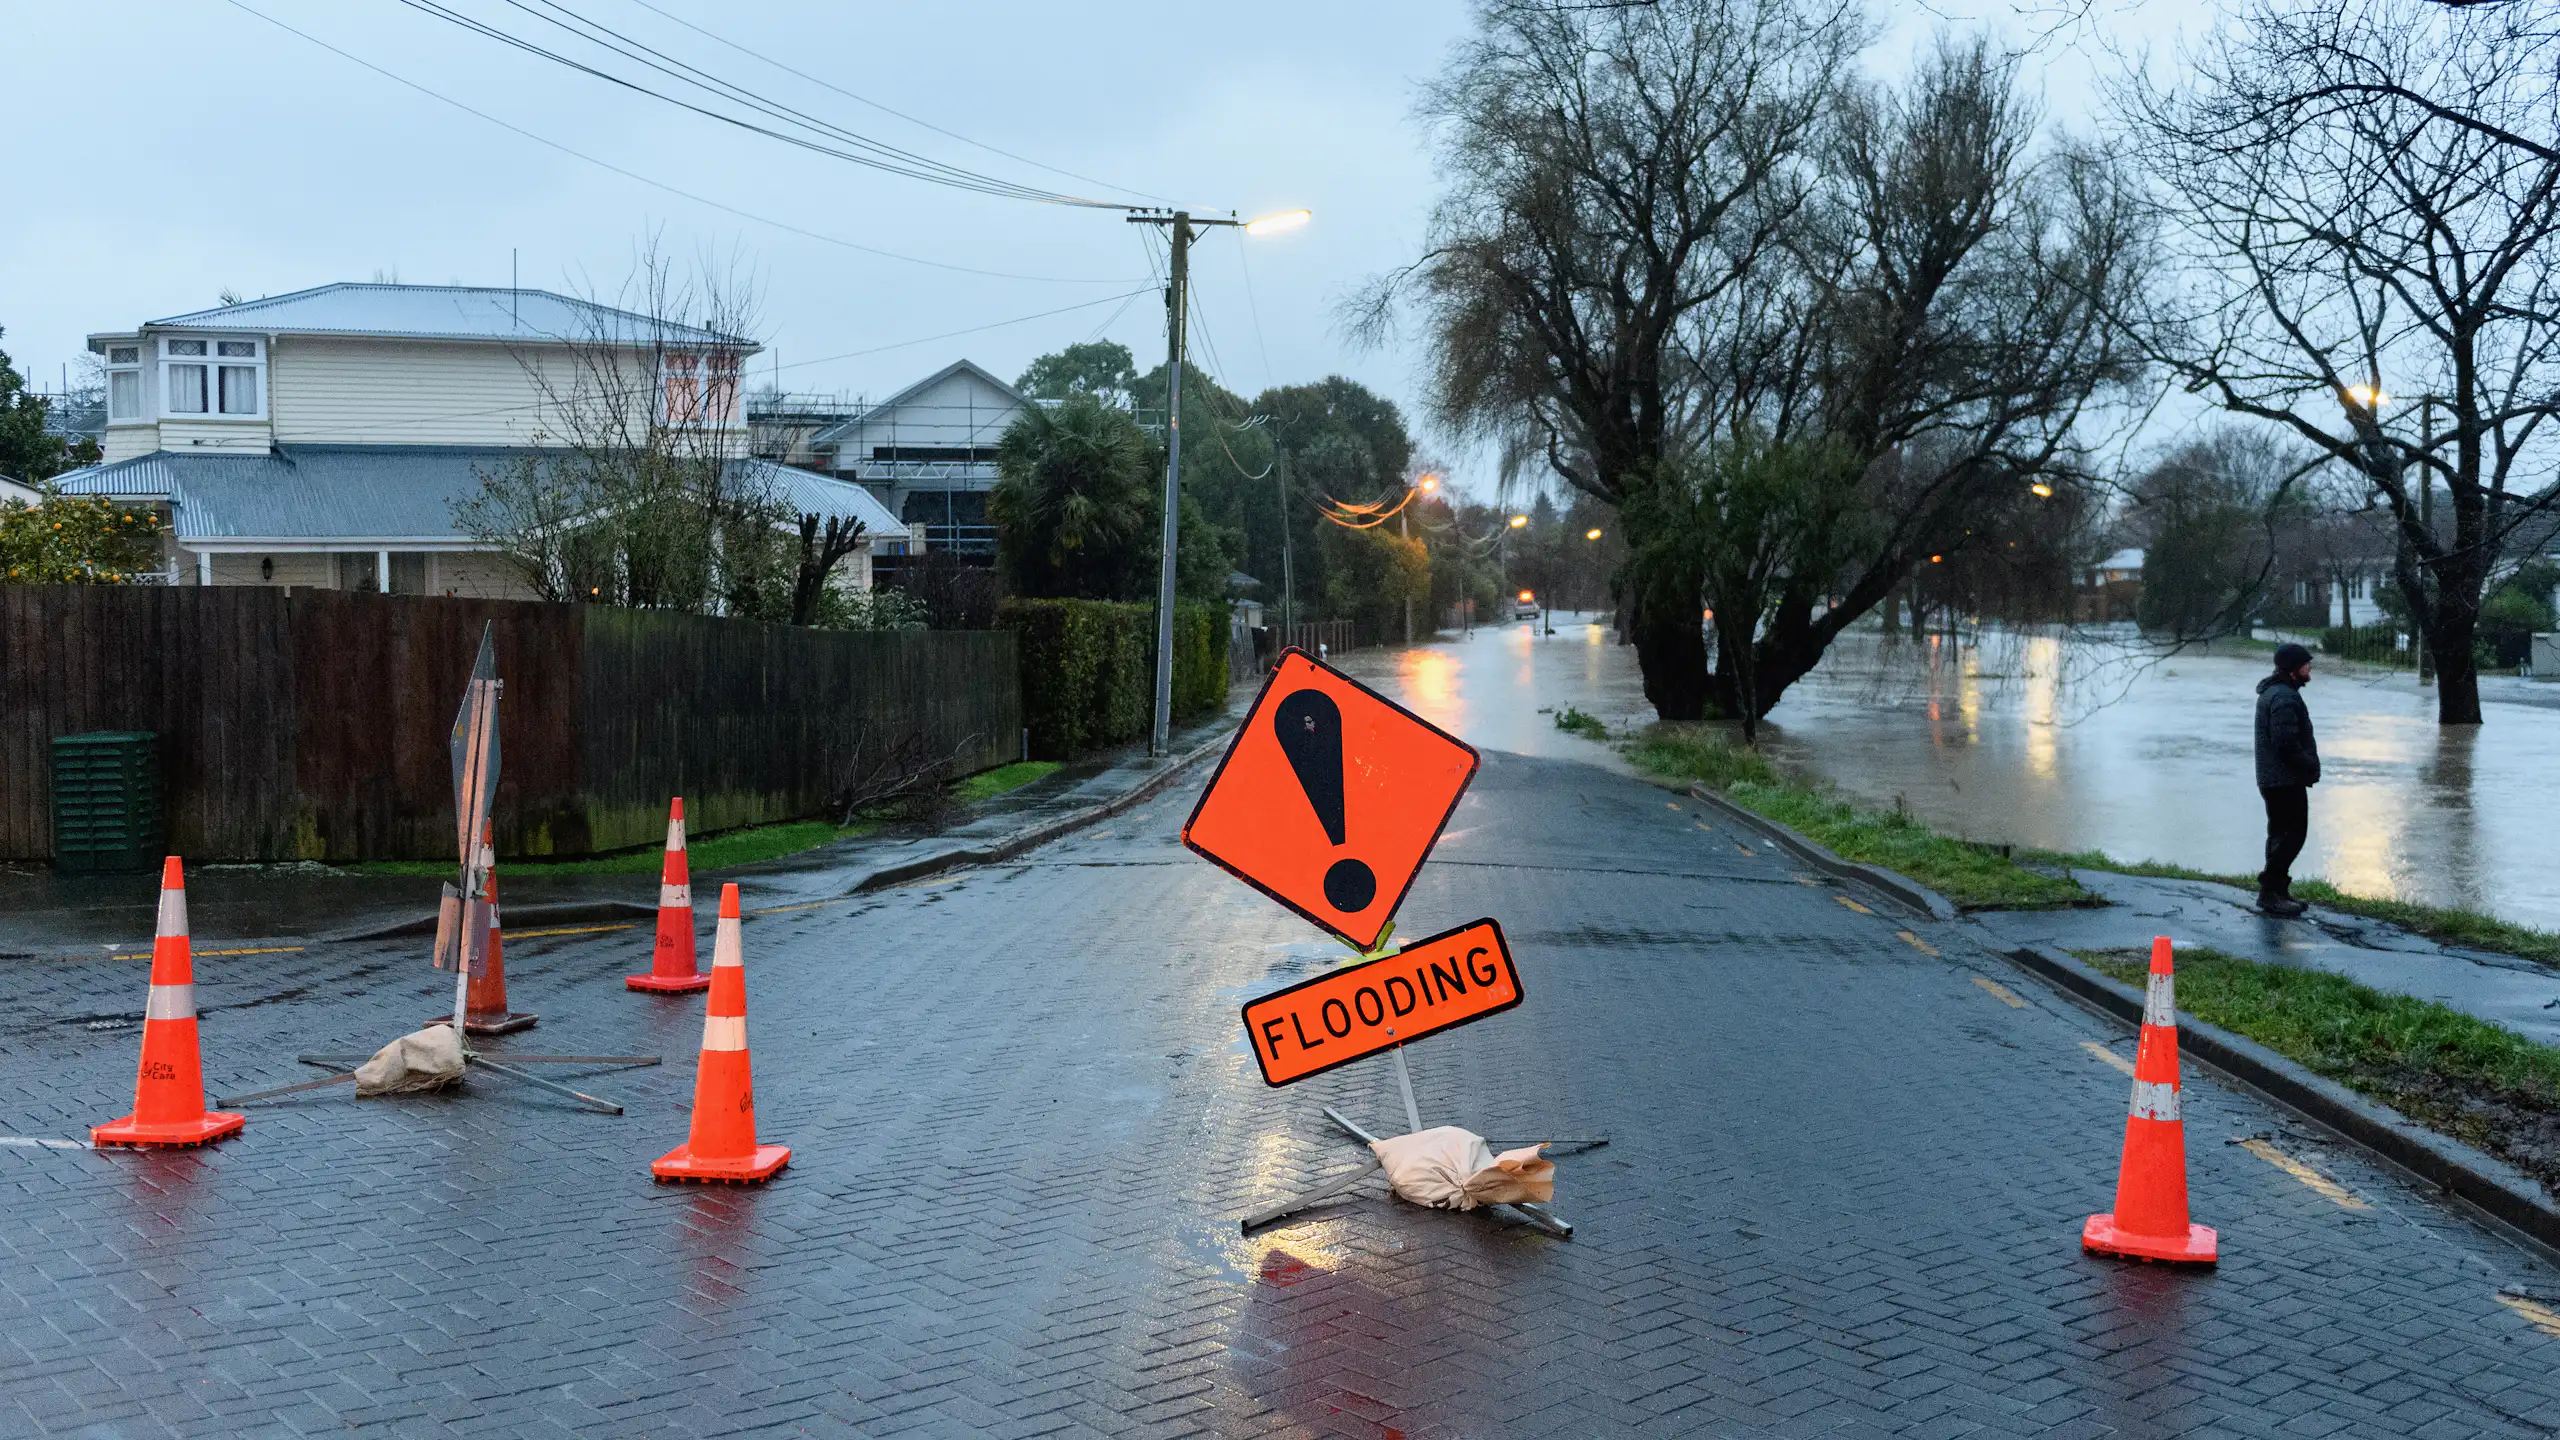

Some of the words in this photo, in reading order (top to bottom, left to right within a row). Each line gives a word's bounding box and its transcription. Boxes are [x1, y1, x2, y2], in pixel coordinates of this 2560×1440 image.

[1261, 947, 1497, 1061] FLOODING
[153, 1062, 173, 1072] City
[152, 1071, 176, 1080] Care
